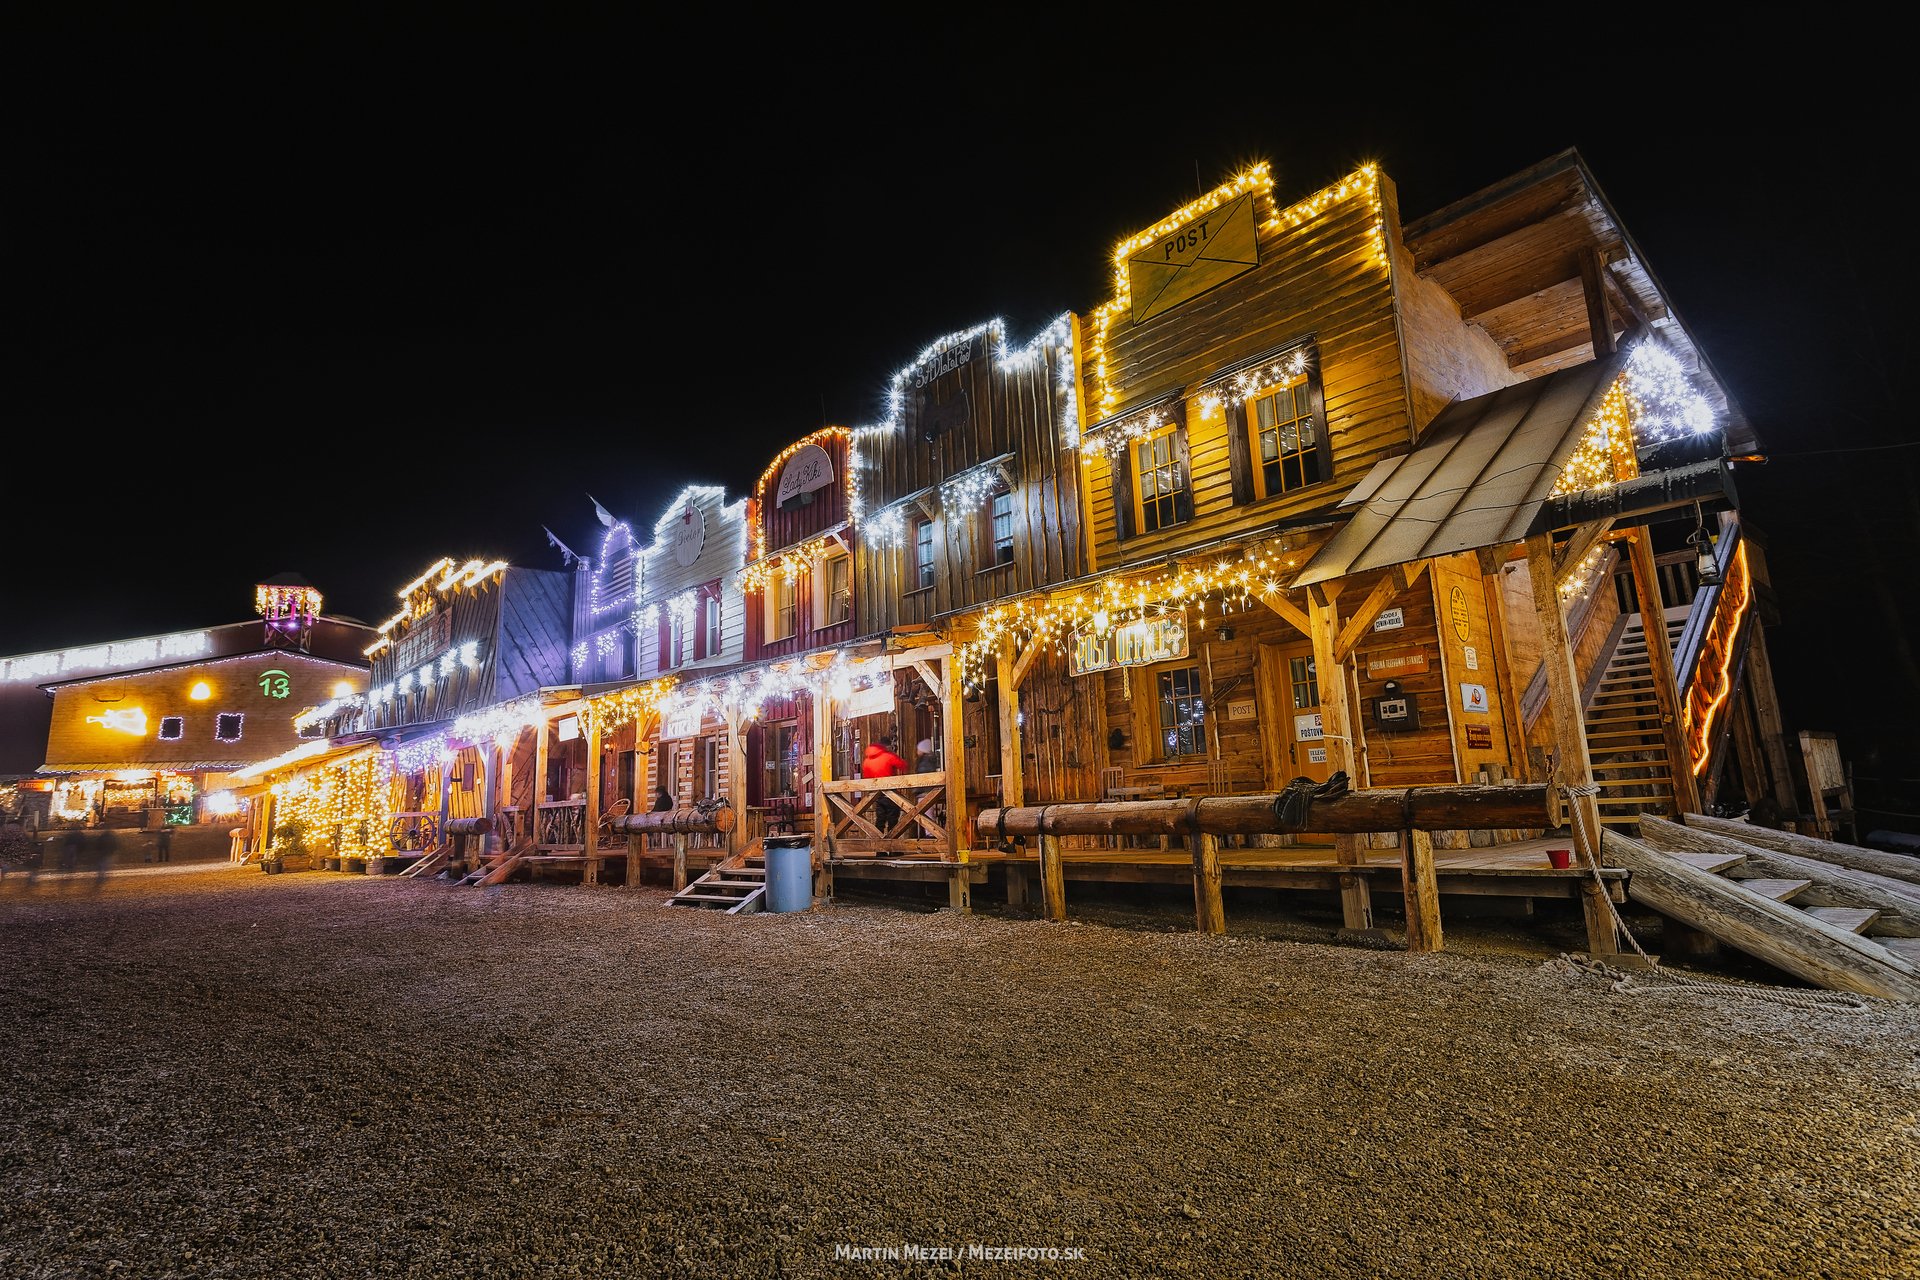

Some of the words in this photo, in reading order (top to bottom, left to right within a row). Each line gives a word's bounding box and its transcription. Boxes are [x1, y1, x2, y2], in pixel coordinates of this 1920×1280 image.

[1165, 221, 1209, 261] POST
[1379, 611, 1398, 620] RODEJ
[1075, 631, 1110, 673] POST
[259, 677, 291, 699] 13
[1232, 704, 1252, 716] POST
[1300, 727, 1324, 738] POŠTOVN
